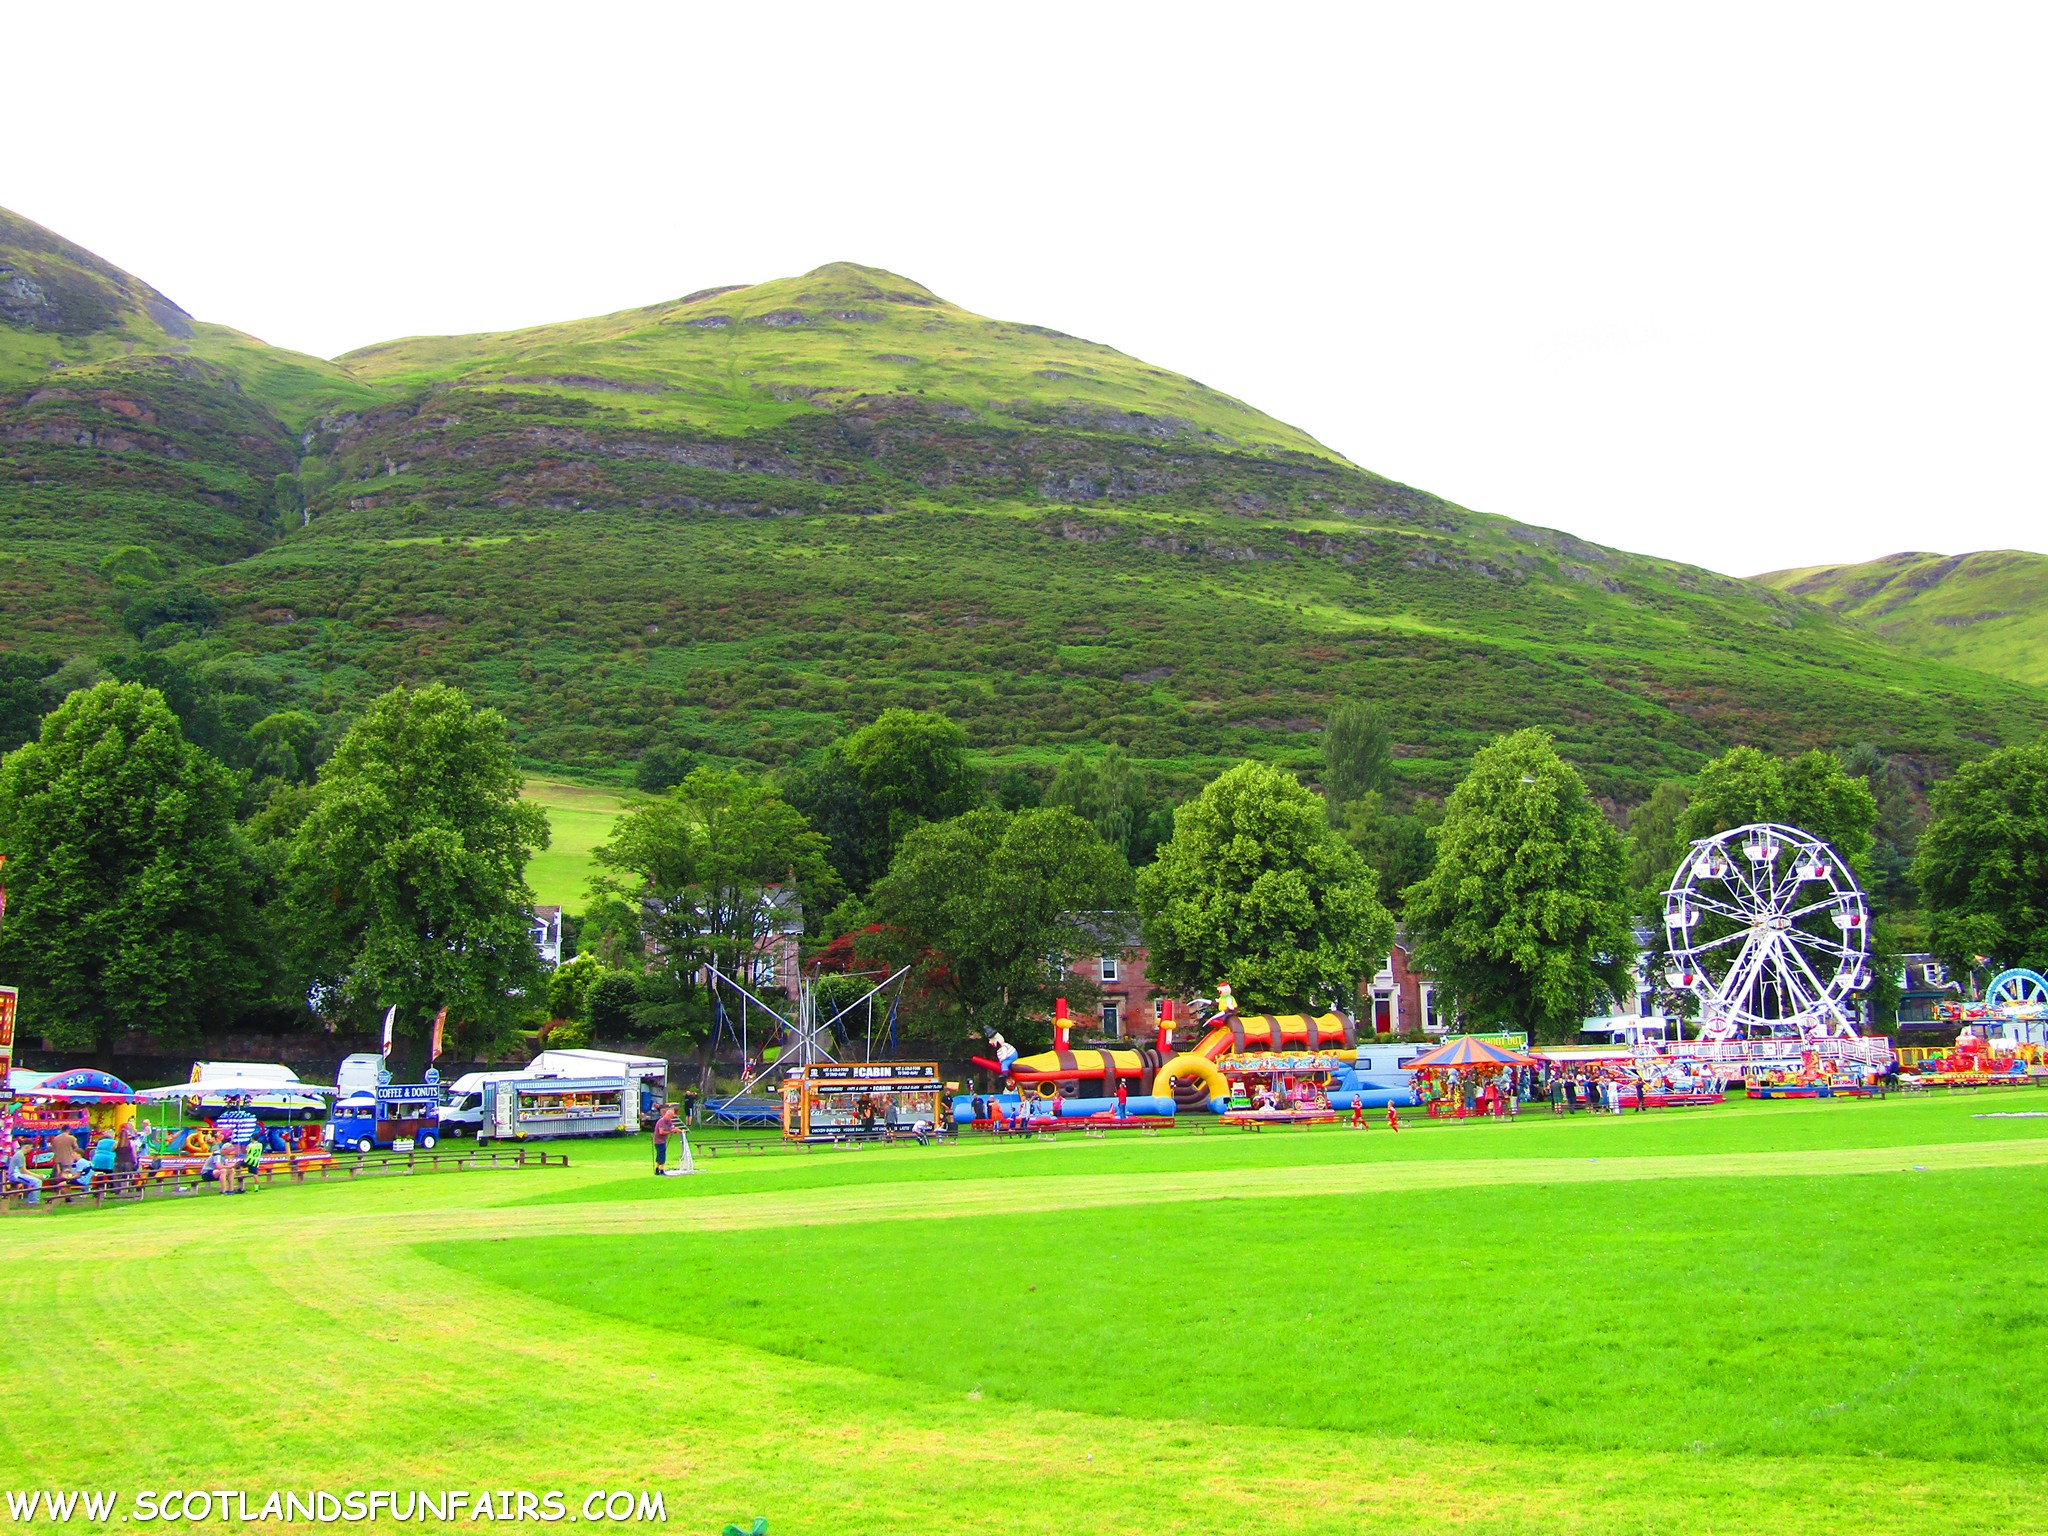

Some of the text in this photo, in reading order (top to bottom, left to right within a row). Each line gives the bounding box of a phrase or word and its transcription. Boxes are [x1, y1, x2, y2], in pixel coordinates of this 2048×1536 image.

[1508, 1036, 1523, 1046] OUT
[859, 1067, 892, 1078] CABIN
[379, 1087, 438, 1098] COFFEE & DONUTS
